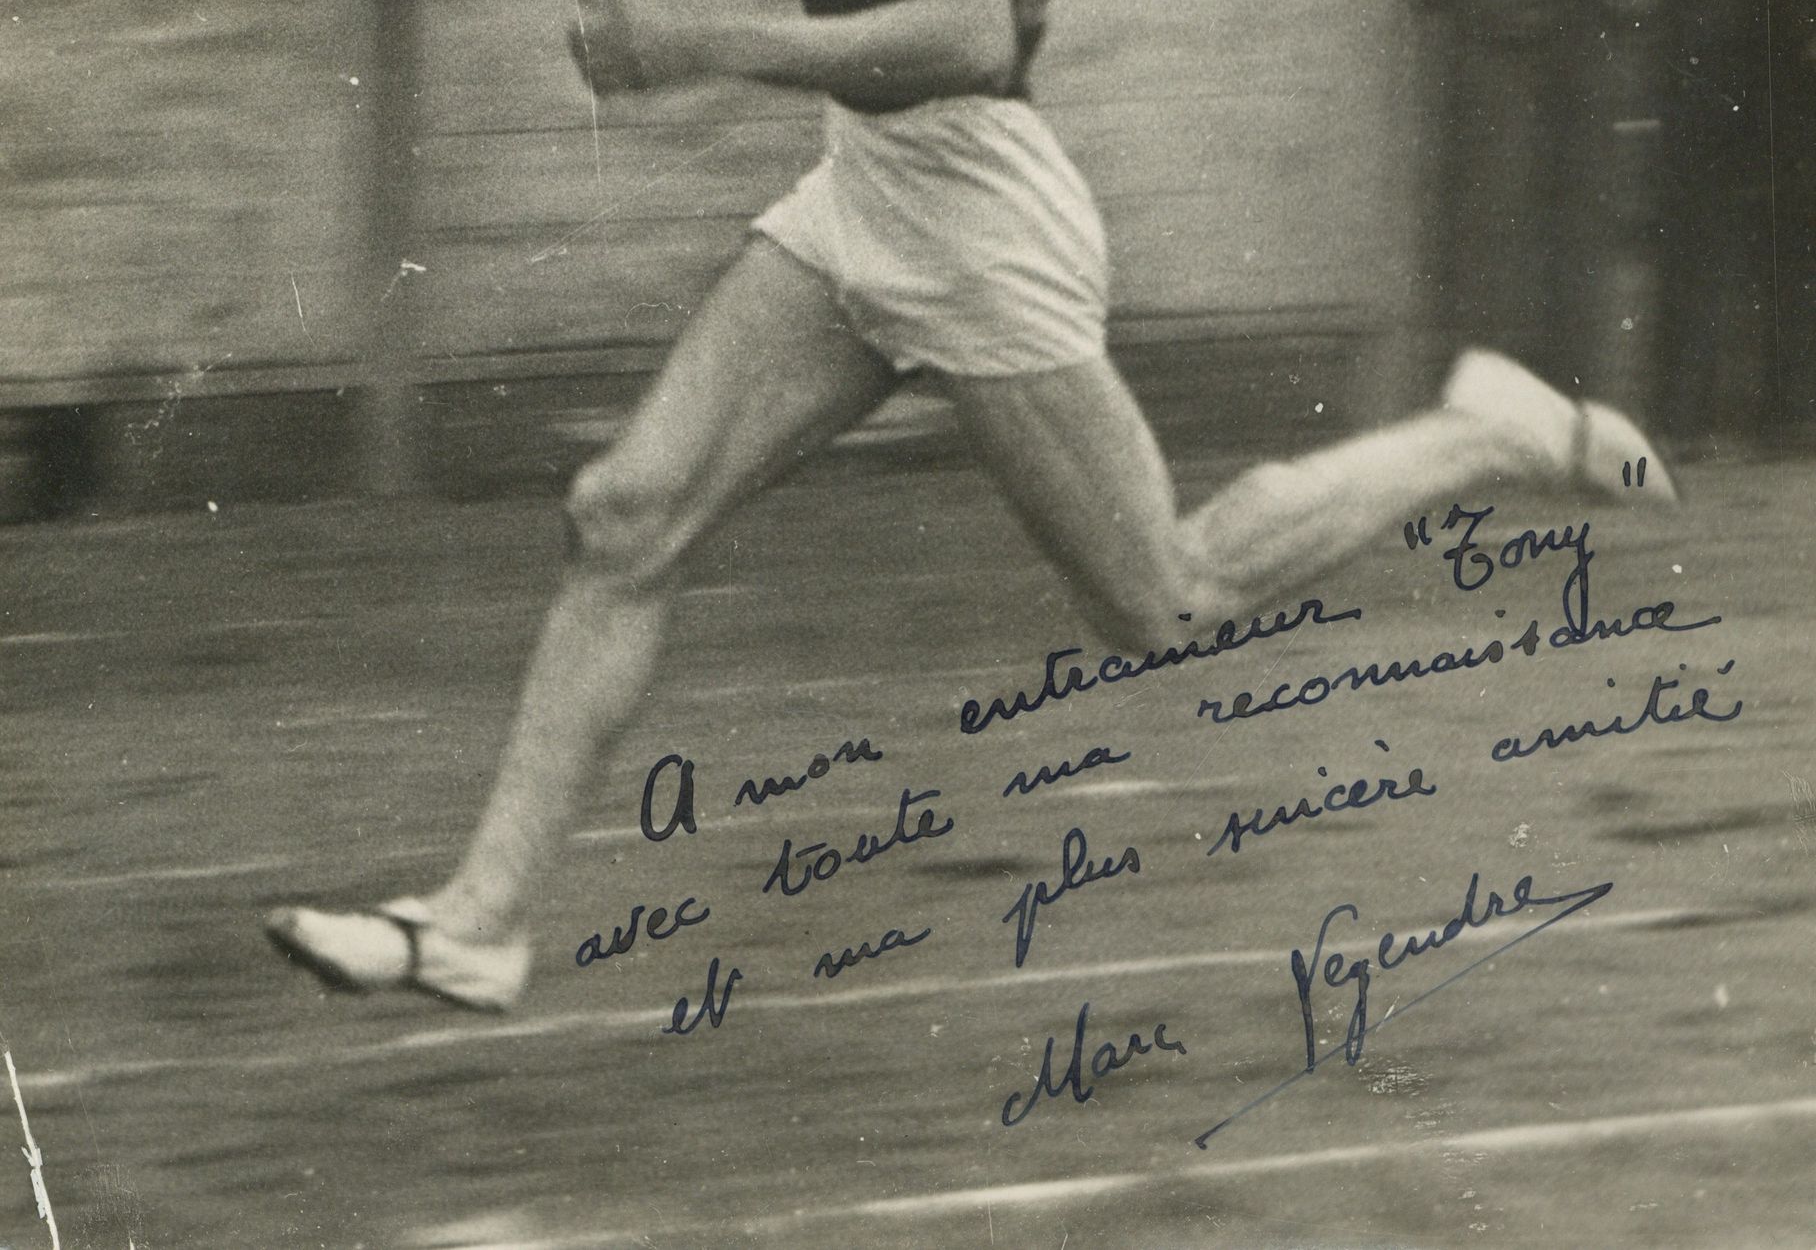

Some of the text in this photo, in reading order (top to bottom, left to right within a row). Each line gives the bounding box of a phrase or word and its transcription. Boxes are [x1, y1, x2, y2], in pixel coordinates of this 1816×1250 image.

[576, 602, 1721, 966] avec toute ma reconnaissance
[641, 754, 697, 841] A
[735, 738, 882, 806] mon
[814, 928, 931, 978] ma
[1003, 828, 1139, 968] plus
[1492, 660, 1742, 761] amitié
[1002, 1002, 1186, 1126] Marc
